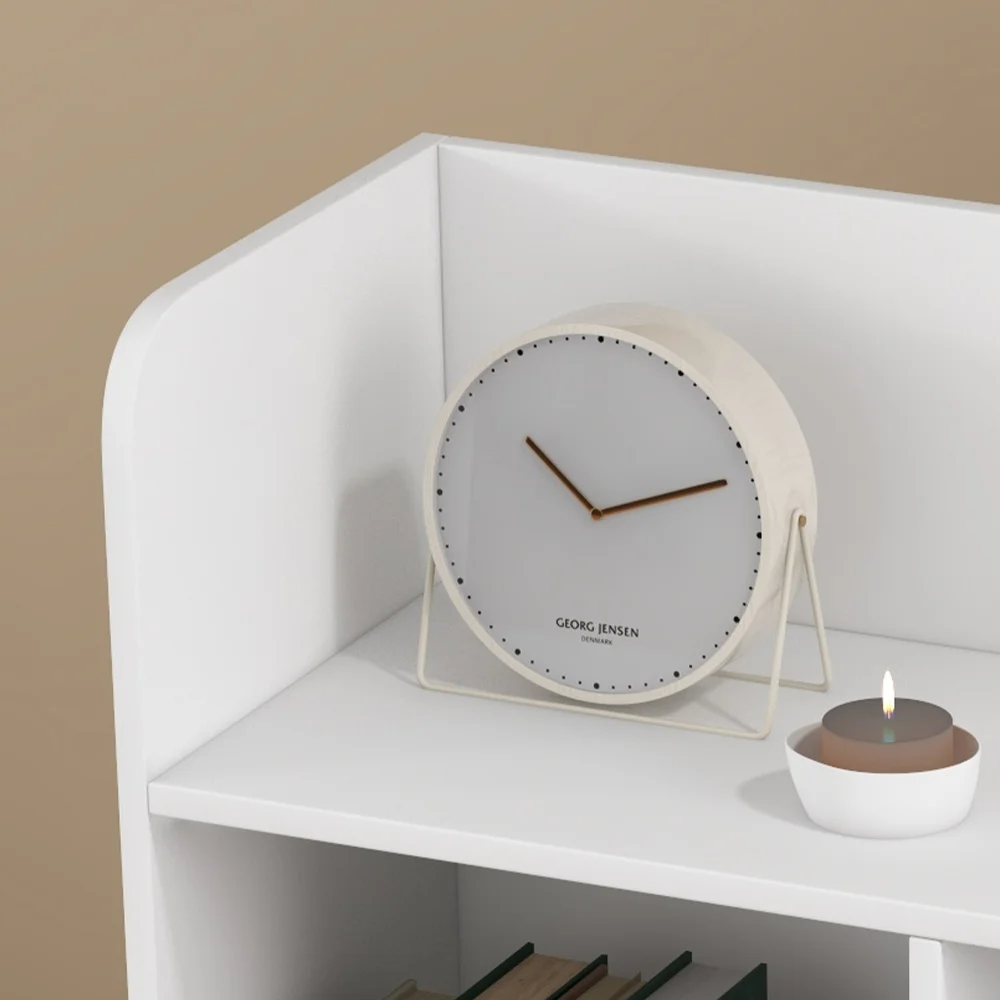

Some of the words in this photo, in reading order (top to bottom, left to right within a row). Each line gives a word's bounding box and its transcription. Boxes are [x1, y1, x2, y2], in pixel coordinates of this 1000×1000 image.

[556, 617, 594, 632] GEORG
[598, 623, 639, 638] JENSEN
[581, 635, 613, 645] DENMARK
